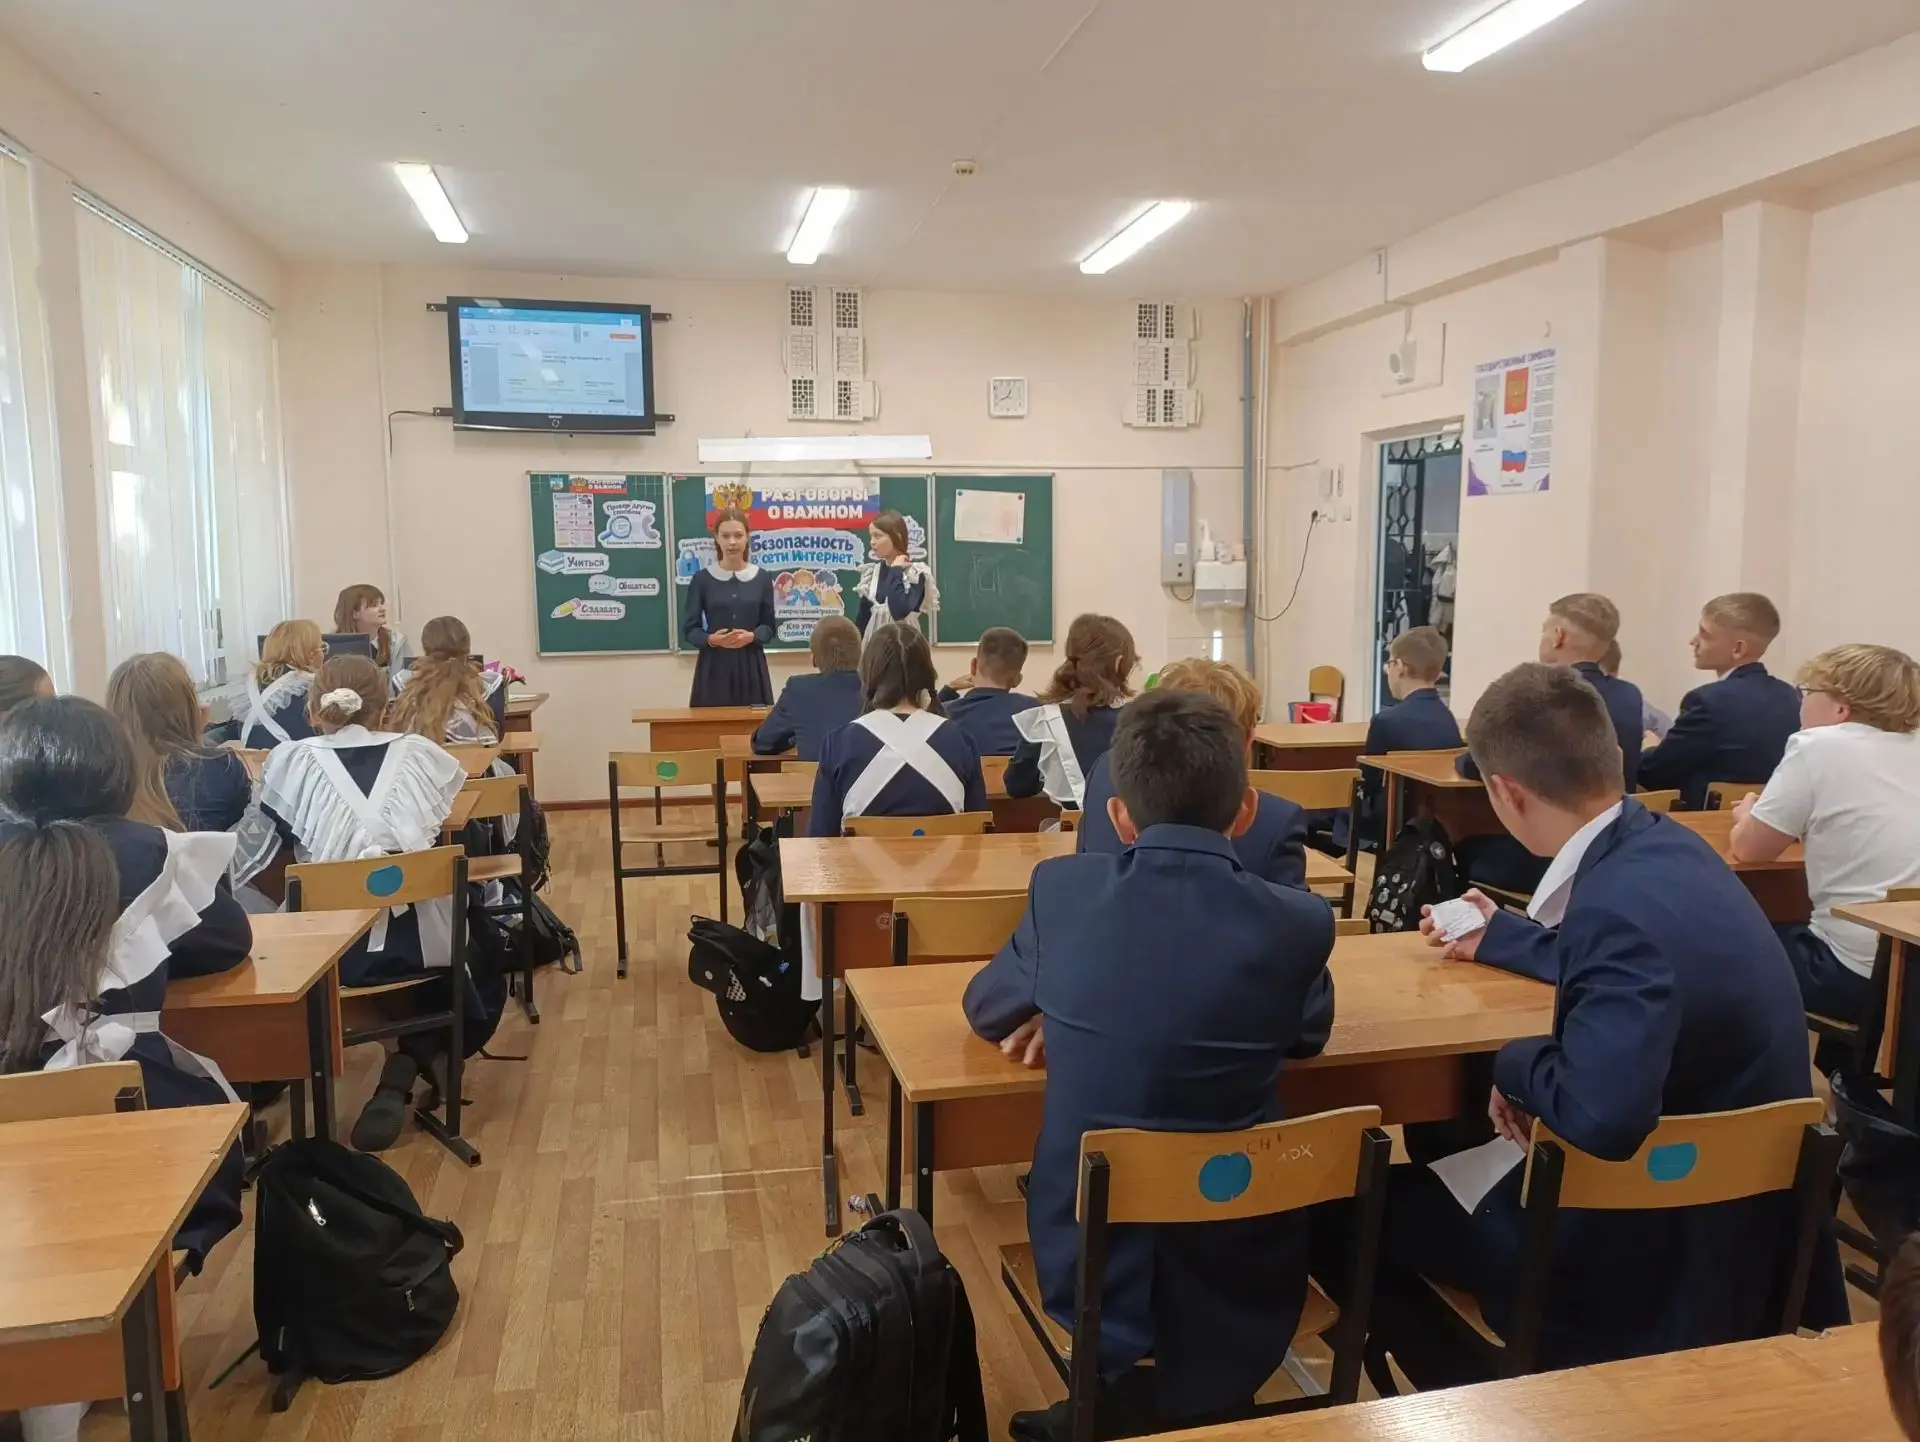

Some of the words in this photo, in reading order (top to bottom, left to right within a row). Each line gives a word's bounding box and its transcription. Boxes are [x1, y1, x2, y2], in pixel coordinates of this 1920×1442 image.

[761, 488, 869, 501] РАЗГОВОРЫ
[767, 505, 780, 519] О
[783, 505, 863, 519] ВАЖНОМ
[751, 534, 854, 552] Безопасность
[567, 556, 605, 567] Учиться
[751, 554, 758, 564] в
[762, 552, 789, 564] сети
[791, 550, 853, 564] Интернет
[619, 581, 656, 590] Общаться
[581, 604, 622, 613] Создавать
